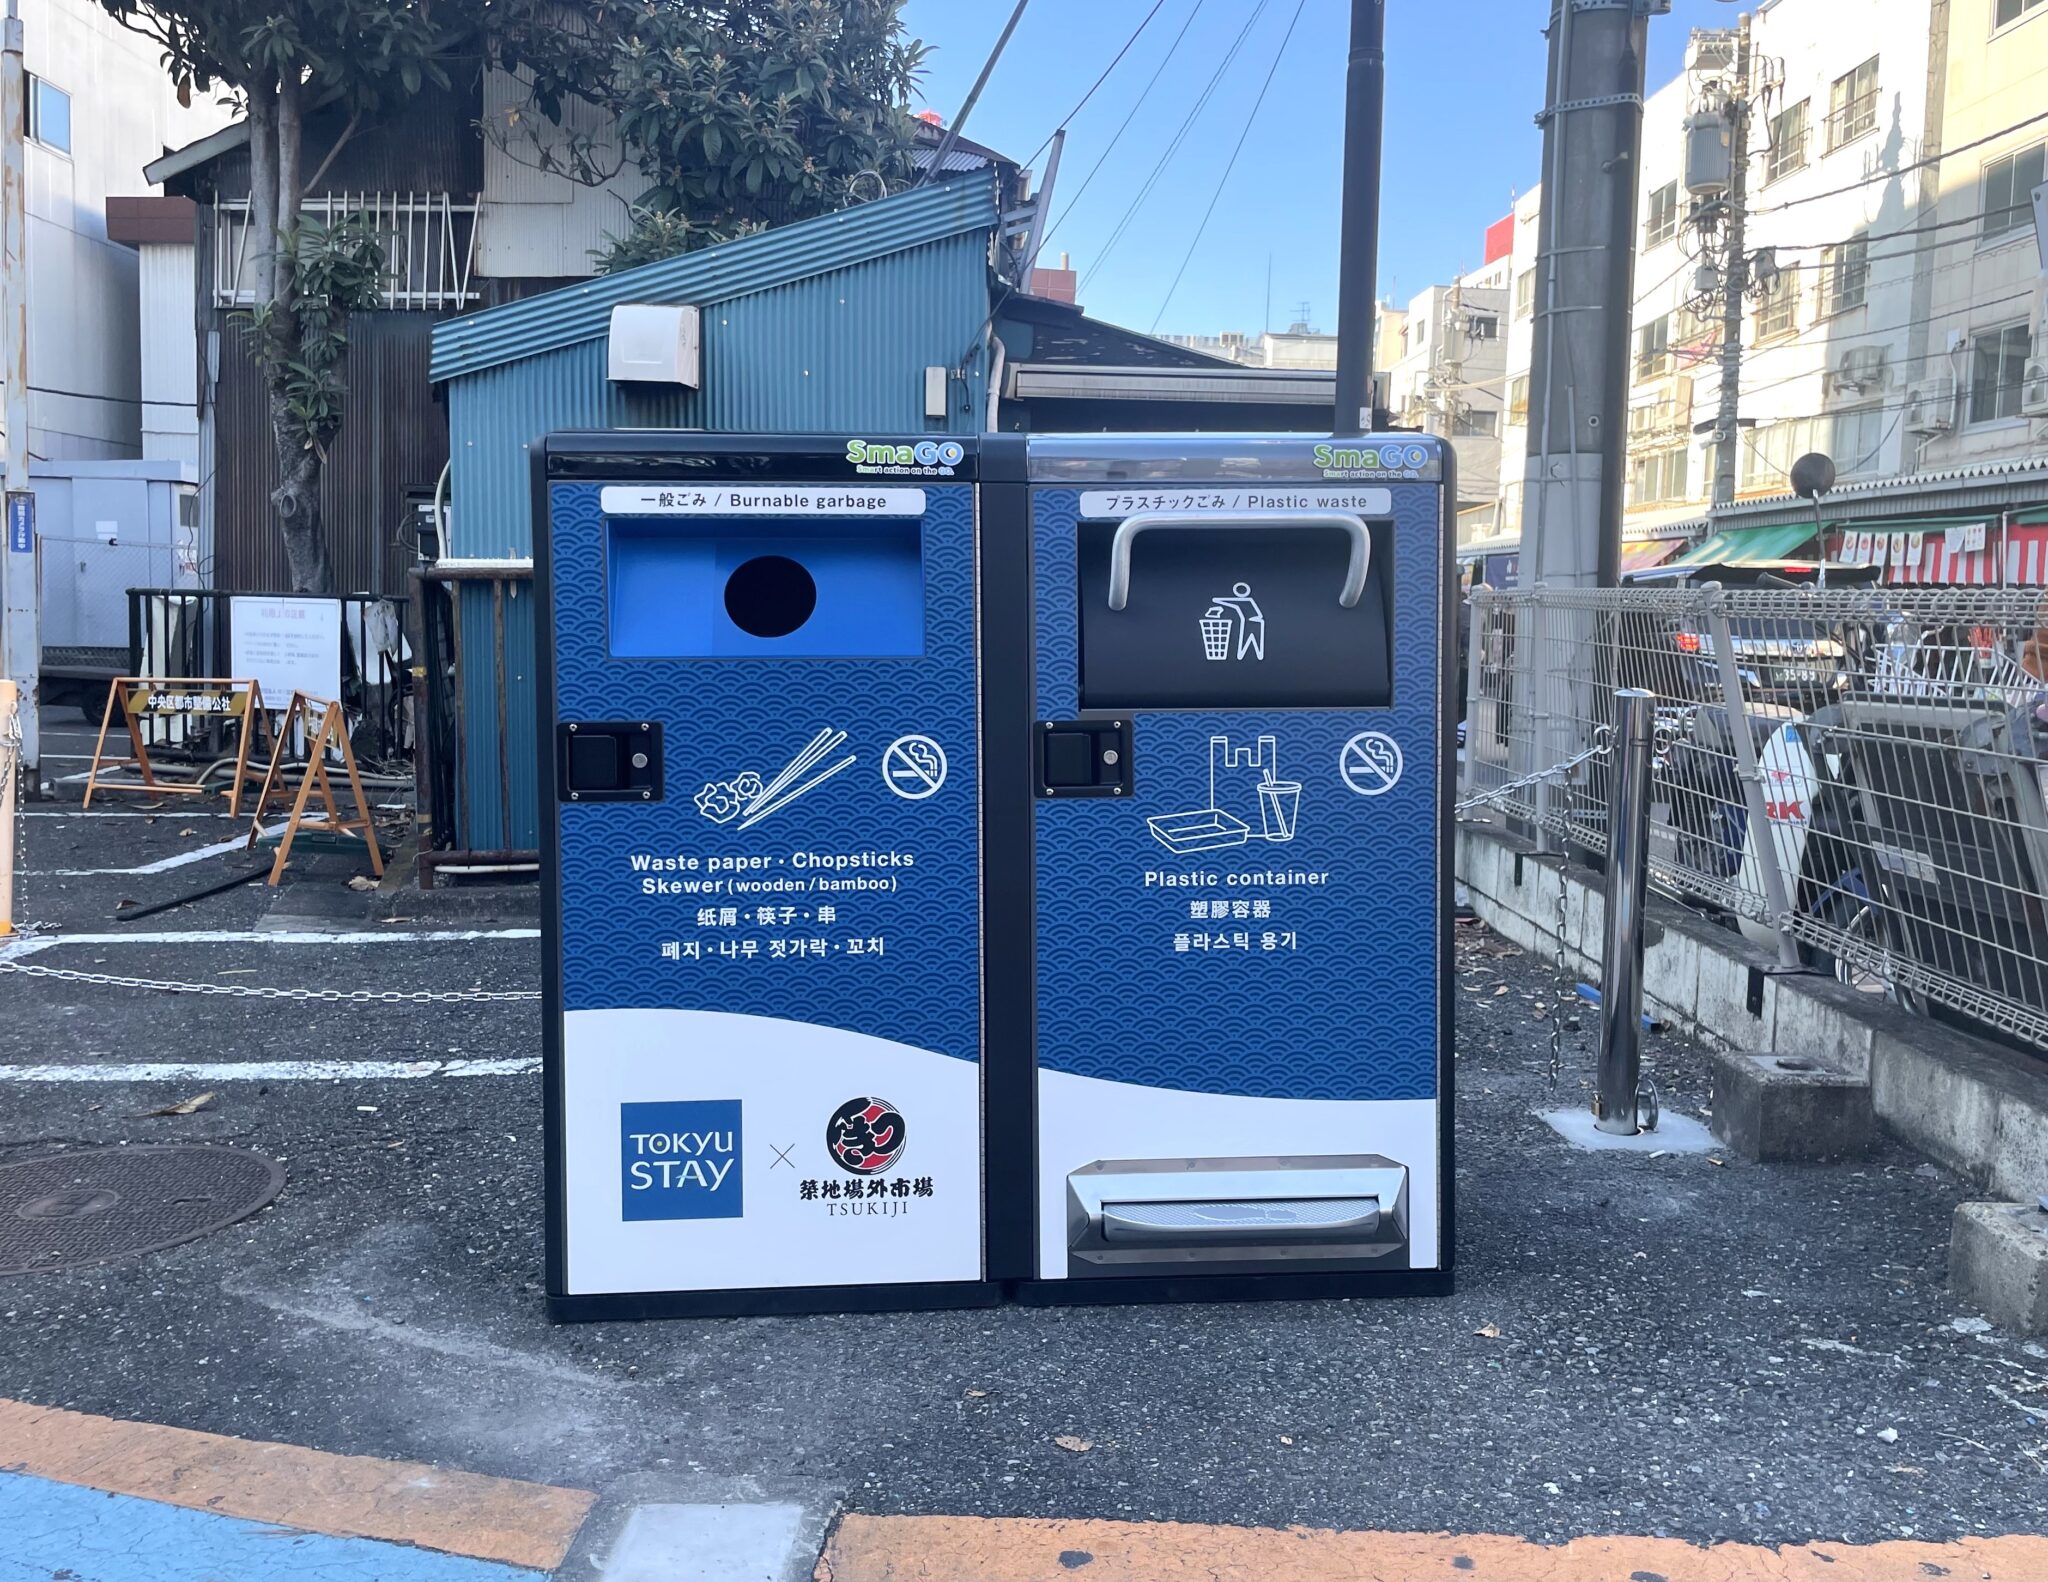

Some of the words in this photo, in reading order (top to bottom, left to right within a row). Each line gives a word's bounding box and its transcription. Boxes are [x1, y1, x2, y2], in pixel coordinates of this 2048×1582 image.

[846, 440, 964, 465] SmaGO
[1314, 444, 1428, 469] SmaGO
[856, 465, 882, 473] Smart
[884, 466, 909, 474] action
[923, 466, 937, 475] the
[1350, 470, 1375, 478] action
[1388, 470, 1401, 478] the
[641, 493, 706, 507] 一般ごみ
[730, 494, 808, 507] Burnable
[817, 495, 886, 509] garbage
[1107, 495, 1225, 510] プラスチックごみ
[1248, 495, 1308, 508] Plastic
[1317, 496, 1367, 508] waste
[631, 855, 699, 871] Waste
[708, 856, 771, 873] paper
[792, 851, 914, 870] Chopsticks
[1144, 871, 1218, 887] Plastic
[1227, 870, 1329, 885] container
[1190, 900, 1272, 918] 塑膠容器
[1173, 932, 1249, 952] 플라스틱
[1260, 931, 1296, 951] 용기
[630, 1131, 733, 1156] TOKYU
[631, 1158, 734, 1191] STAY
[800, 1177, 934, 1200] 築地場外市場
[827, 1202, 908, 1217] TSUKIJI
